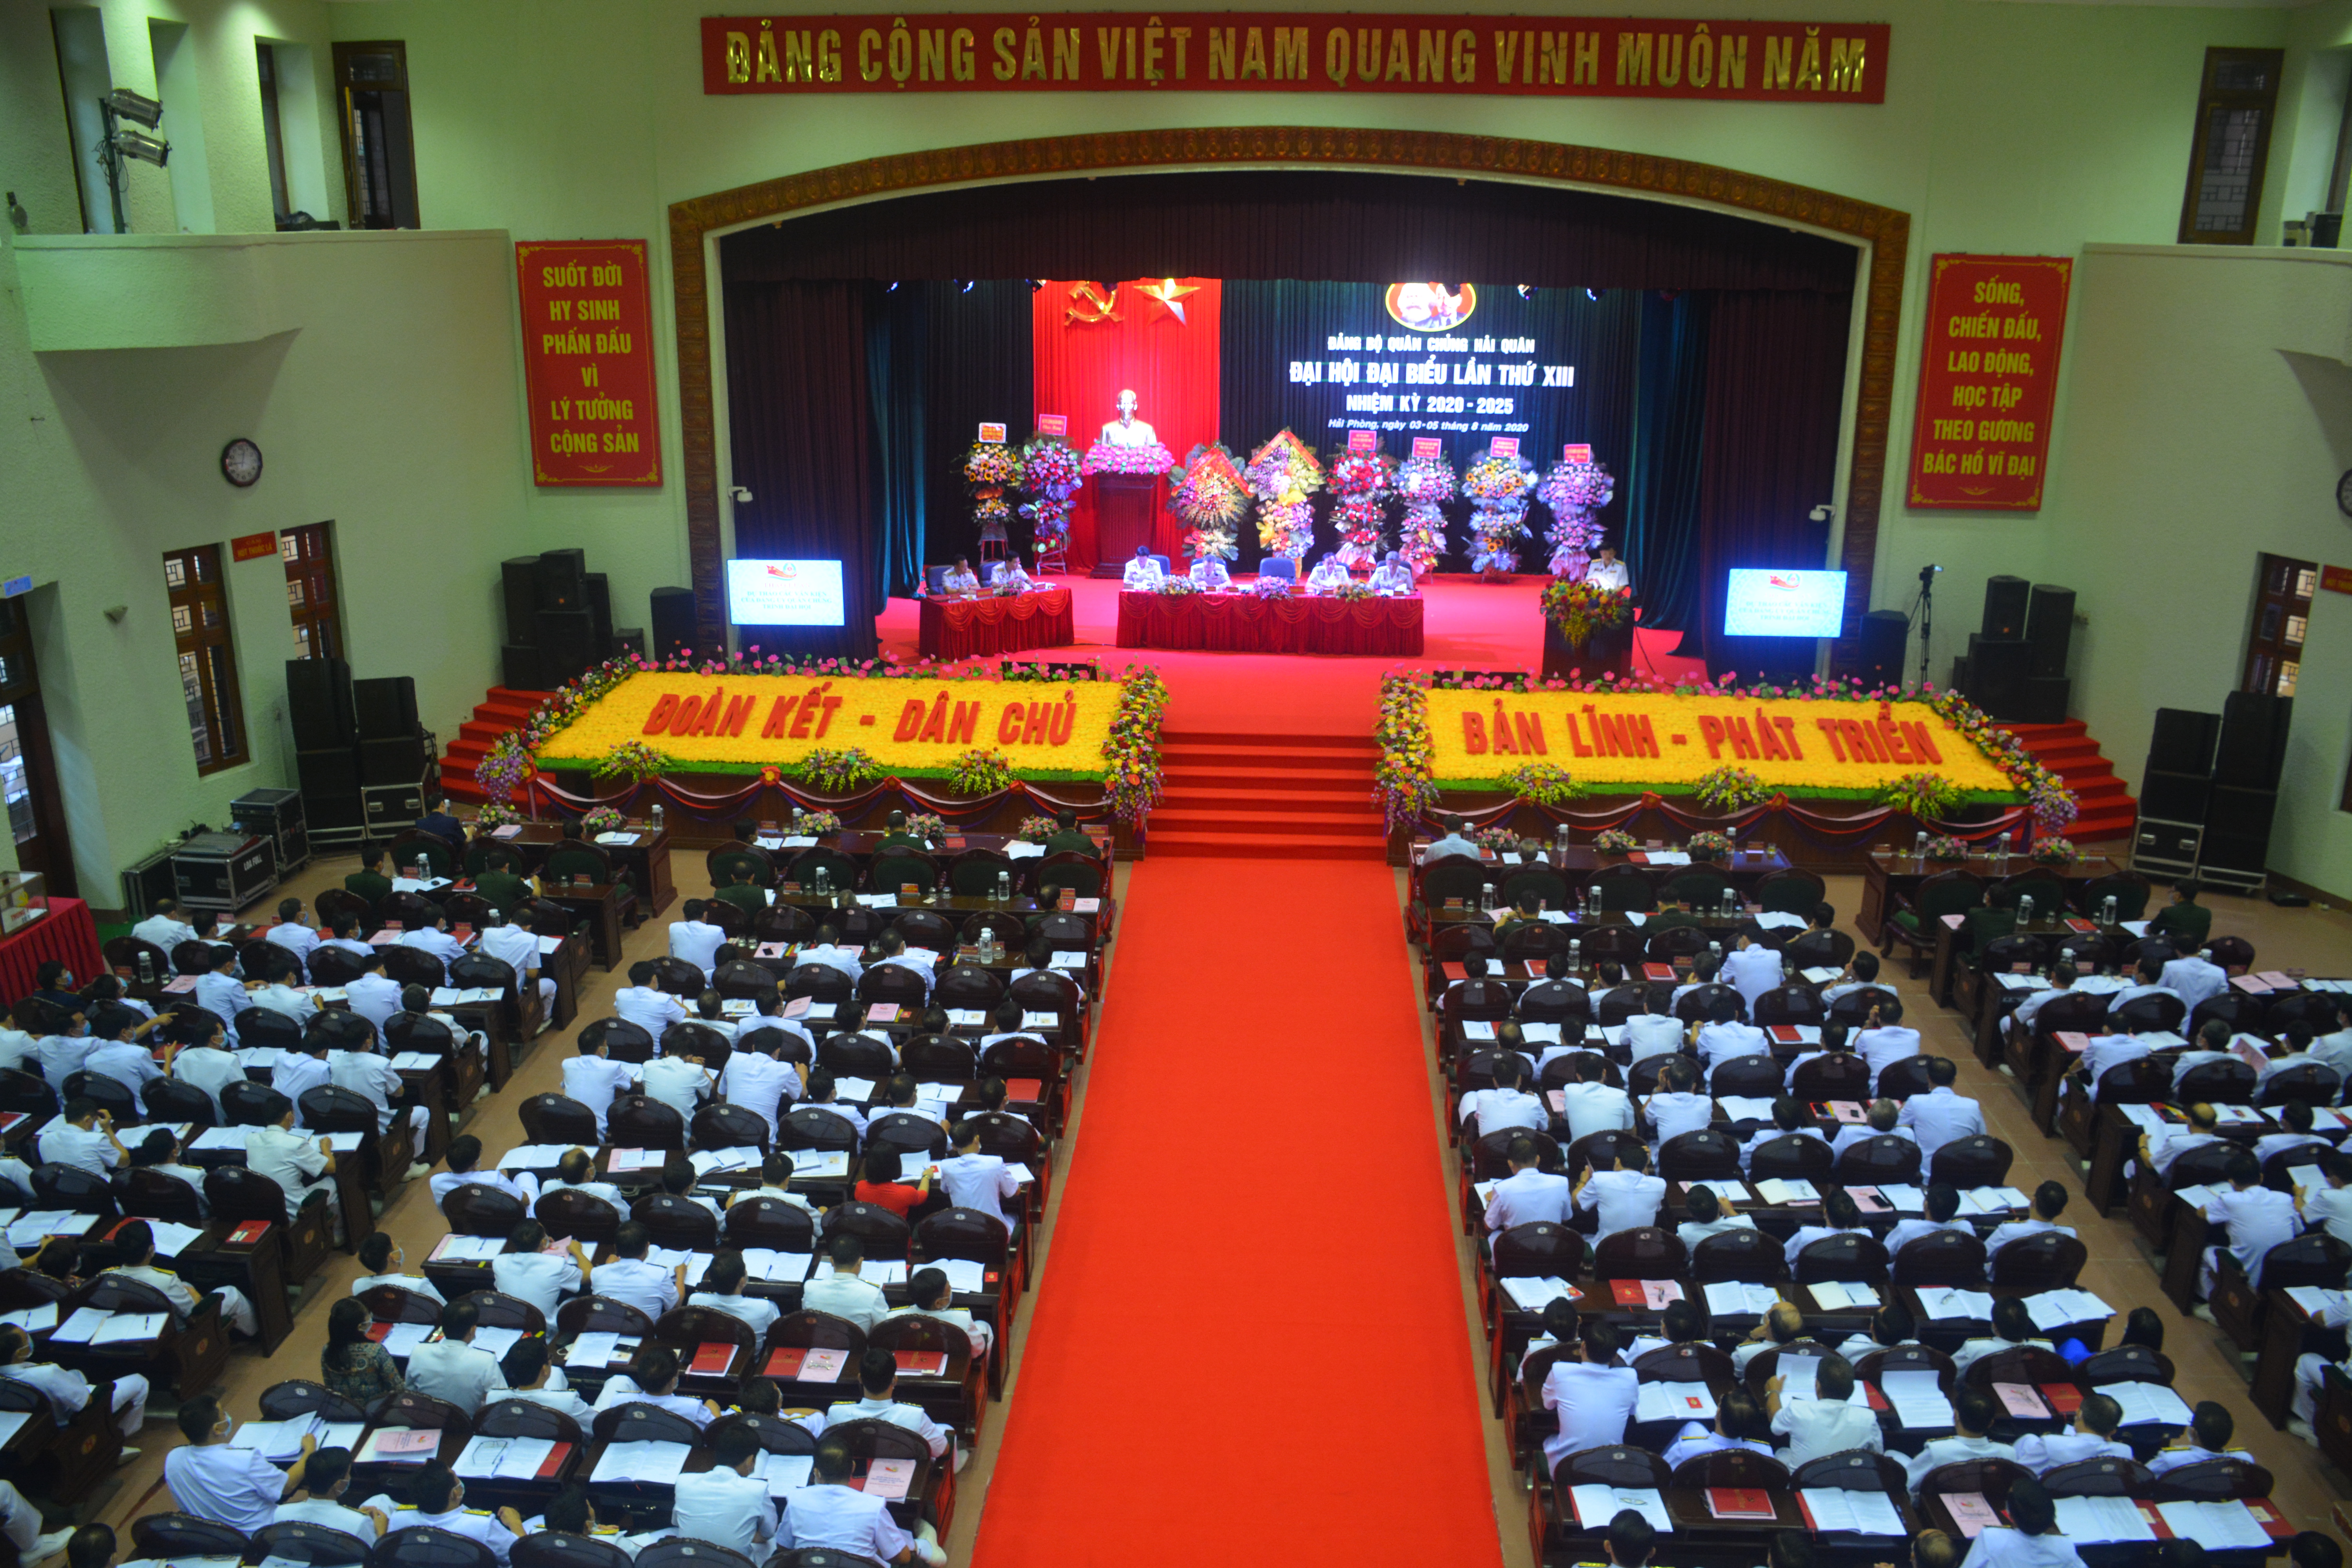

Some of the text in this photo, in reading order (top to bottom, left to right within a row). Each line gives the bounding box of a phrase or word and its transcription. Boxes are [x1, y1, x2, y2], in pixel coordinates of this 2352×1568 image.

[726, 16, 1866, 93] ĐẢNG CỘNG SẢN VIỆT NAM QUANG VINH MUÔN NĂM
[543, 259, 622, 287] SUỐT ĐỜI
[1974, 275, 2024, 307] SỐNG,
[549, 299, 620, 321] HY SINH
[543, 326, 631, 354] PHẤN ĐẤU
[1949, 310, 2042, 342] CHIẾN ĐẤU,
[1328, 333, 1535, 354] ĐẢNG BỘ QUÂN CHỦNG HẢI QUÂN
[581, 363, 598, 387] VÌ
[1289, 354, 1574, 388] ĐẠI HỘI ĐẠI BIỂU LẦN THỨ XIII
[1947, 348, 2034, 377] LAO ĐỘNG,
[551, 392, 633, 420] LÝ TƯỞNG
[1347, 392, 1393, 414] NHIỆM
[1399, 393, 1421, 412] KỲ
[1427, 396, 1463, 413] 2020
[1477, 398, 1513, 414] 2025
[1952, 382, 2023, 412] HỌC TẬP
[1328, 418, 1345, 428] Hải
[1347, 419, 1379, 430] Phòng,
[1381, 419, 1406, 431] ngày
[1441, 421, 1469, 433] tháng
[1471, 421, 1479, 431] 8
[1481, 422, 1502, 432] năm
[1504, 423, 1529, 432] 2020
[1933, 419, 2035, 442] THEO GƯƠNG
[550, 425, 639, 457] CỘNG SẢN
[1923, 447, 2036, 481] BÁC HỒ VĨ ĐẠI
[642, 686, 756, 737] ĐOÀN
[761, 682, 843, 739] KẾT
[893, 690, 980, 744] DÂN
[997, 690, 1077, 746] CHỦ
[1463, 698, 1548, 755] BẢN
[1568, 704, 1660, 758] LĨNH
[1698, 708, 1803, 761] PHÁT
[1816, 701, 1943, 765] TRIỂN
